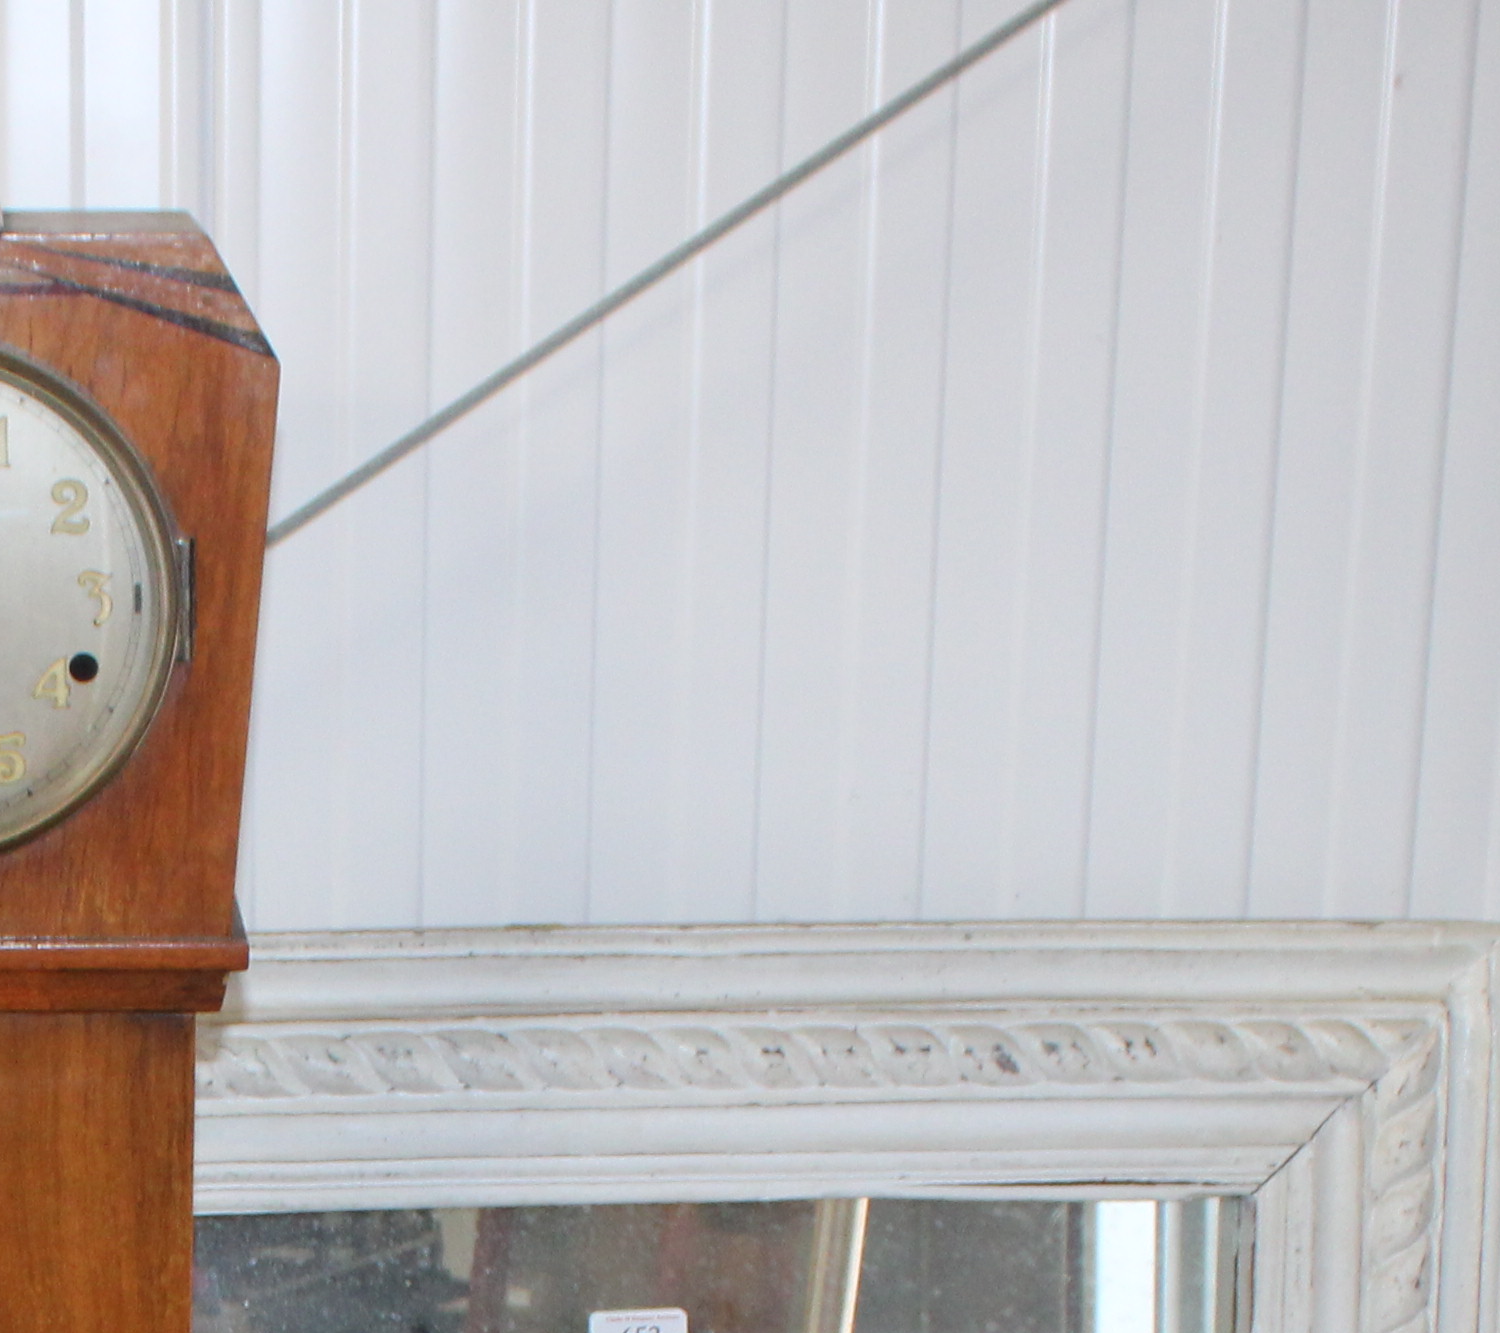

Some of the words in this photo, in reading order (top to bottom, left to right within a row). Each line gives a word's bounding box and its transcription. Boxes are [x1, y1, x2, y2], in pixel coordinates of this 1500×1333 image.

[51, 478, 92, 536] 2
[75, 570, 113, 626] 3
[32, 658, 71, 708] 4
